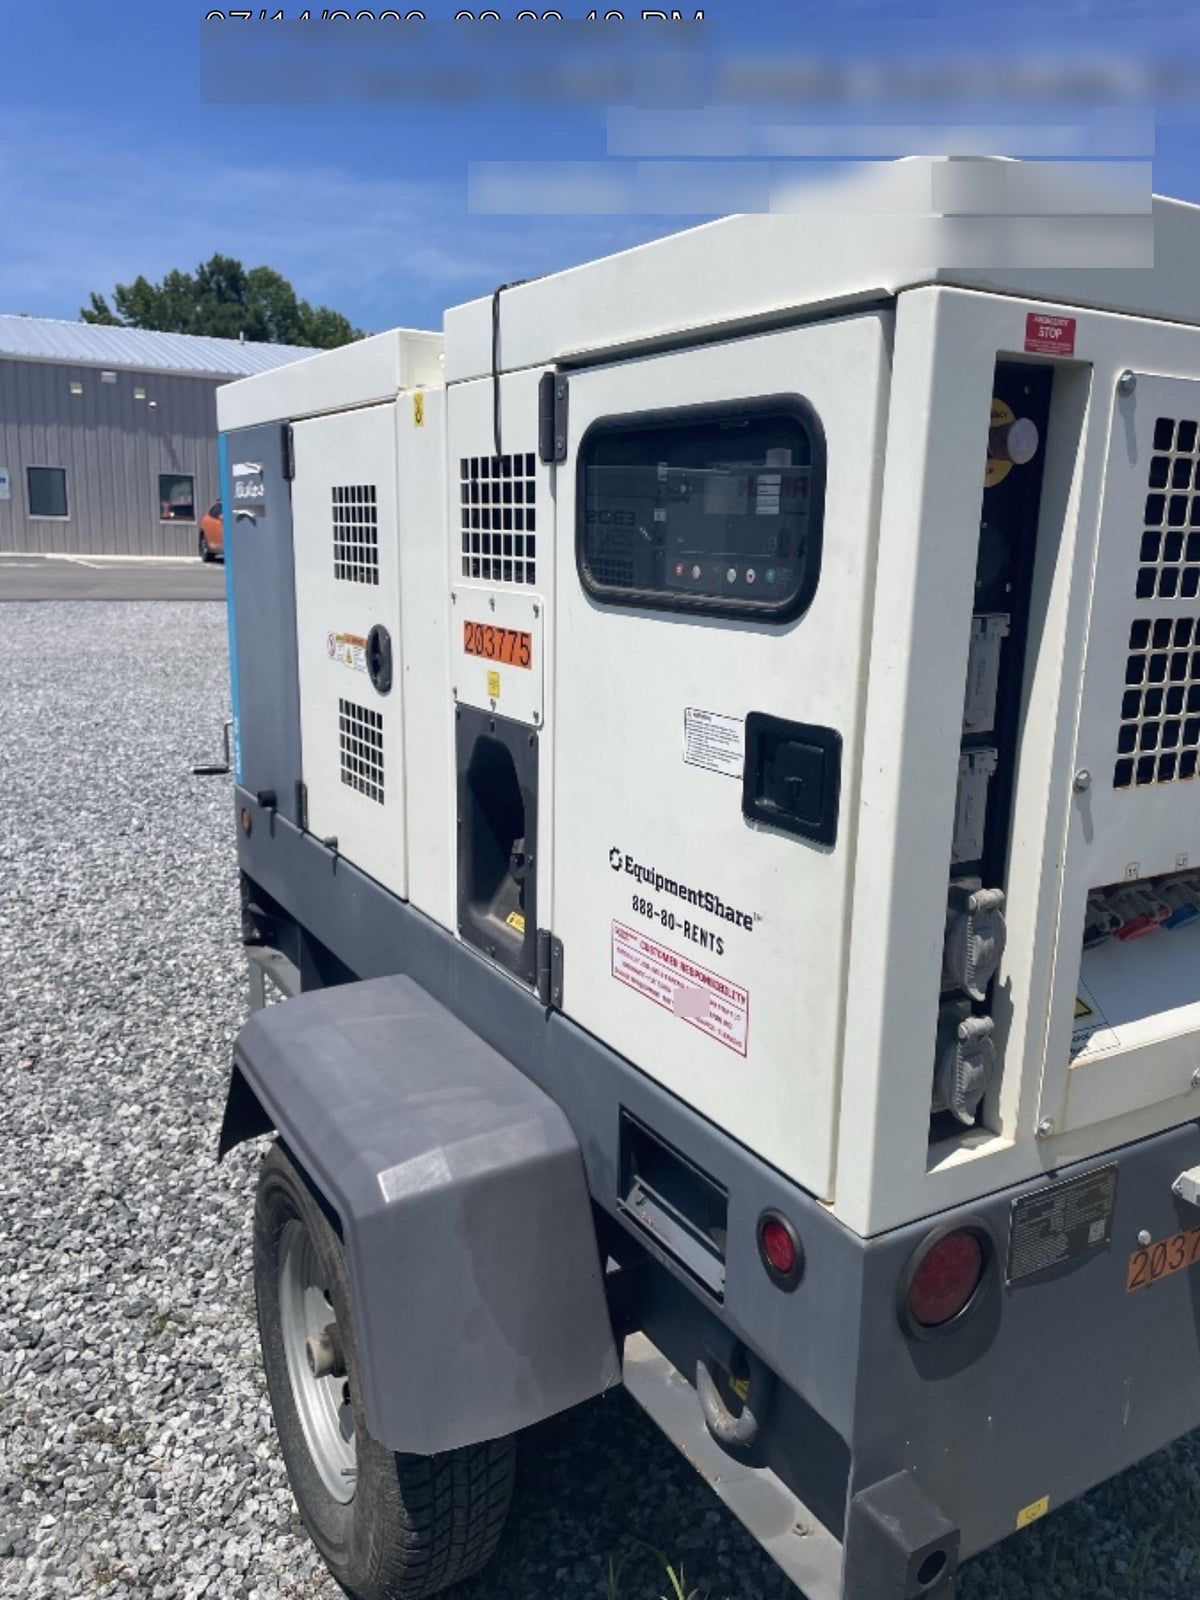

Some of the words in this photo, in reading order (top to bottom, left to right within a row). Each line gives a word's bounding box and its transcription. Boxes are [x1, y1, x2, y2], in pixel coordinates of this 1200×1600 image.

[1038, 326, 1063, 340] STOP
[464, 621, 531, 667] 203775
[632, 893, 725, 956] 888-80-RENTS
